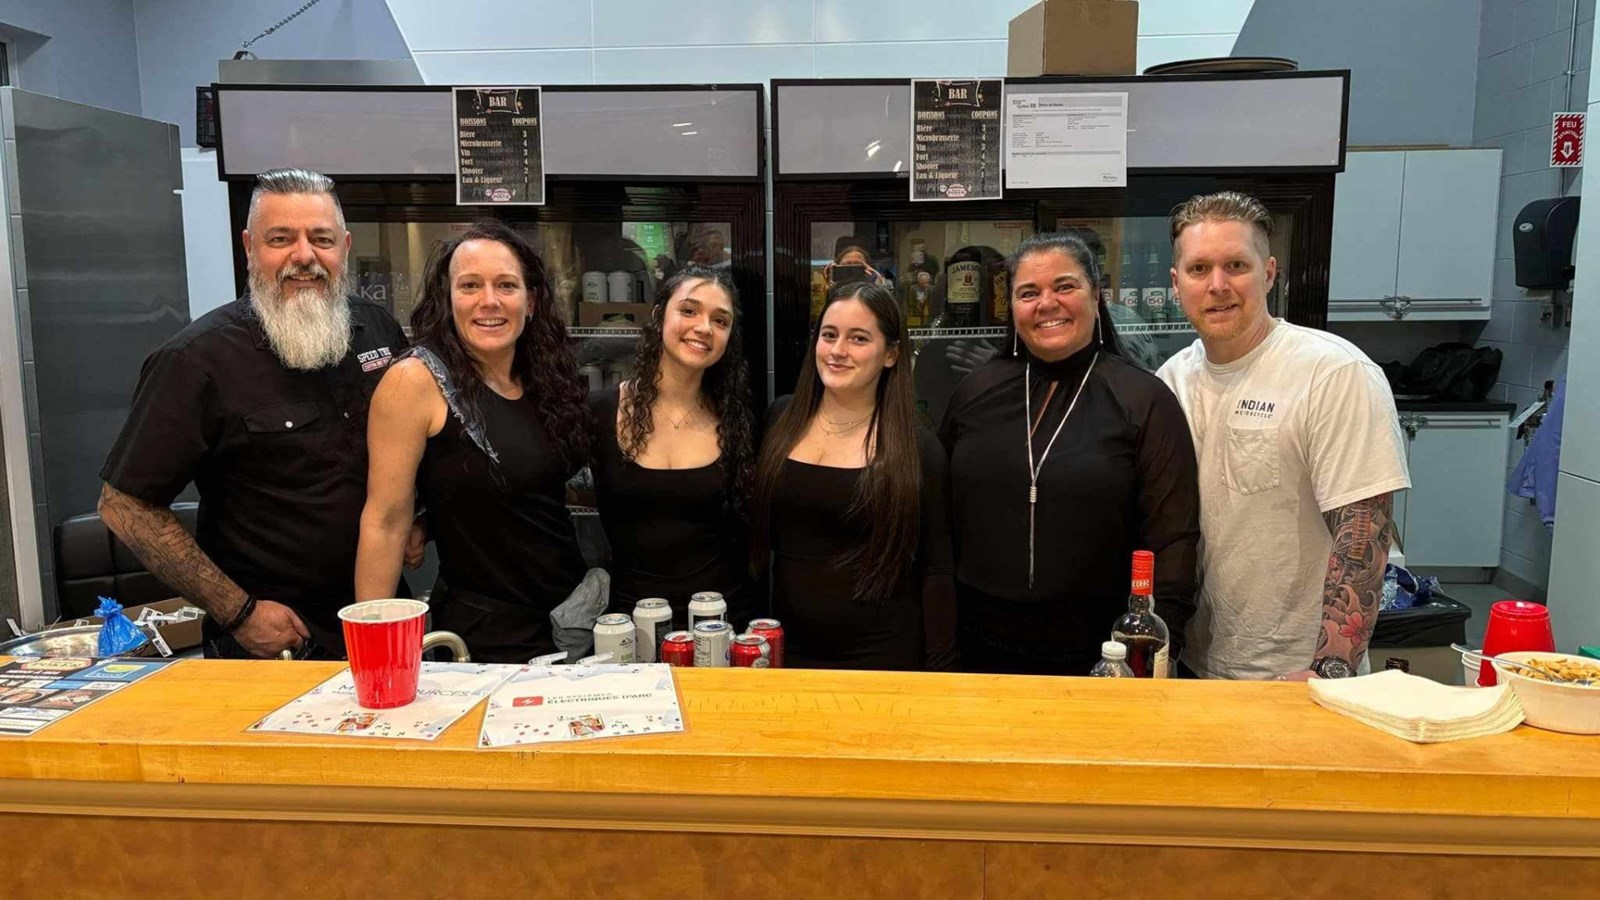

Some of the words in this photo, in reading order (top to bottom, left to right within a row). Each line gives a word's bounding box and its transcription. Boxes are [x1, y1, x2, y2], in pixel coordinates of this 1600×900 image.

[948, 88, 968, 99] BAR
[489, 96, 507, 107] BAR
[917, 111, 945, 119] BOISSONS
[971, 110, 998, 119] COUPONS
[460, 118, 487, 126] BOISSONS
[512, 117, 537, 126] COUPONS
[522, 130, 527, 138] 3
[952, 264, 979, 274] JAMESO
[1236, 399, 1275, 413] INDIAN
